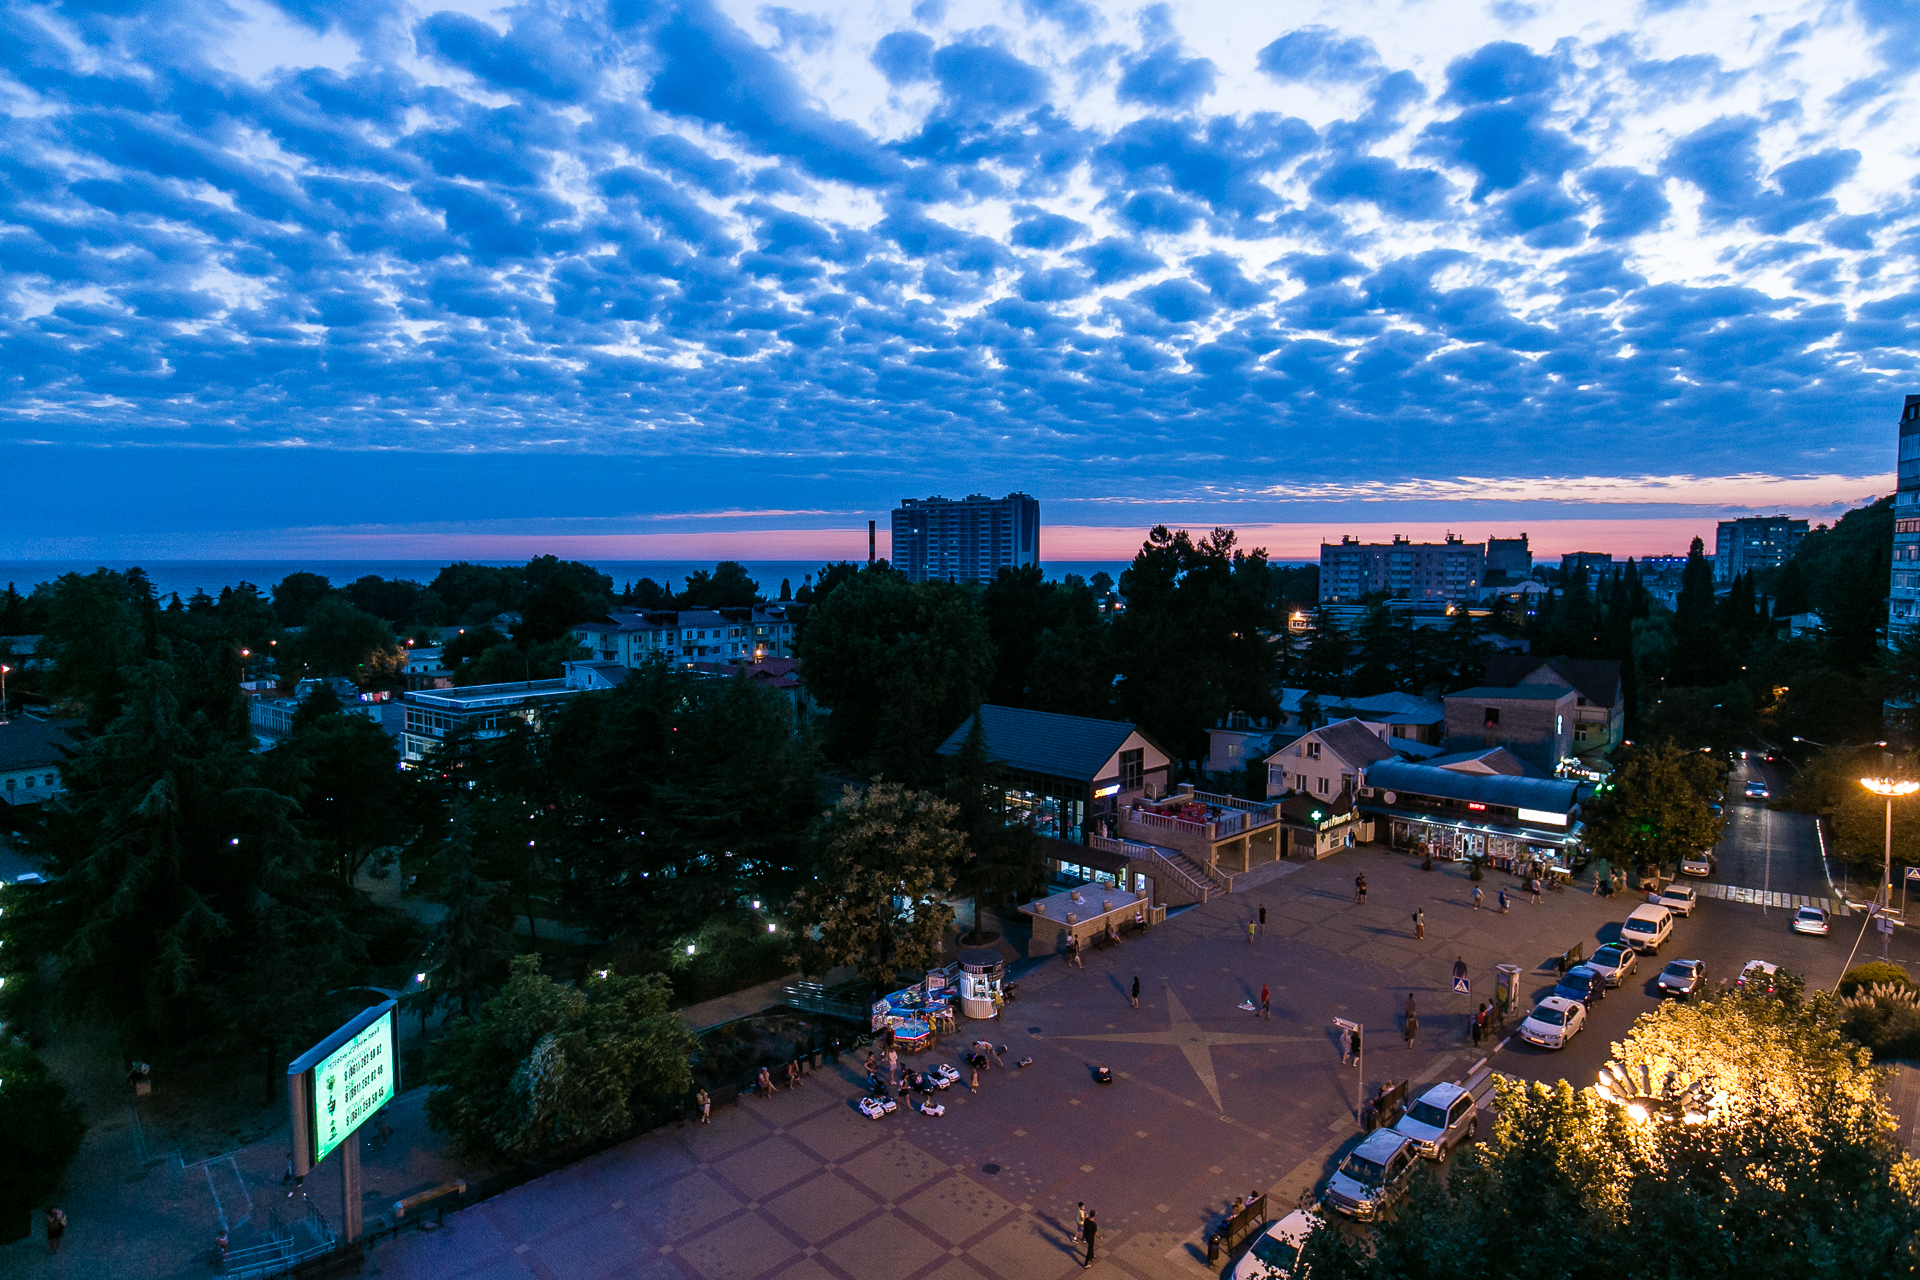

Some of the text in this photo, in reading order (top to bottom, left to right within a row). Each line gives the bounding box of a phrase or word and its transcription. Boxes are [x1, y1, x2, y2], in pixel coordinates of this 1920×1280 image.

[1093, 784, 1120, 799] SUBY
[964, 963, 983, 974] COFFEE
[344, 1070, 348, 1081] 8
[345, 1092, 348, 1102] 8
[346, 1115, 349, 1126] 8
